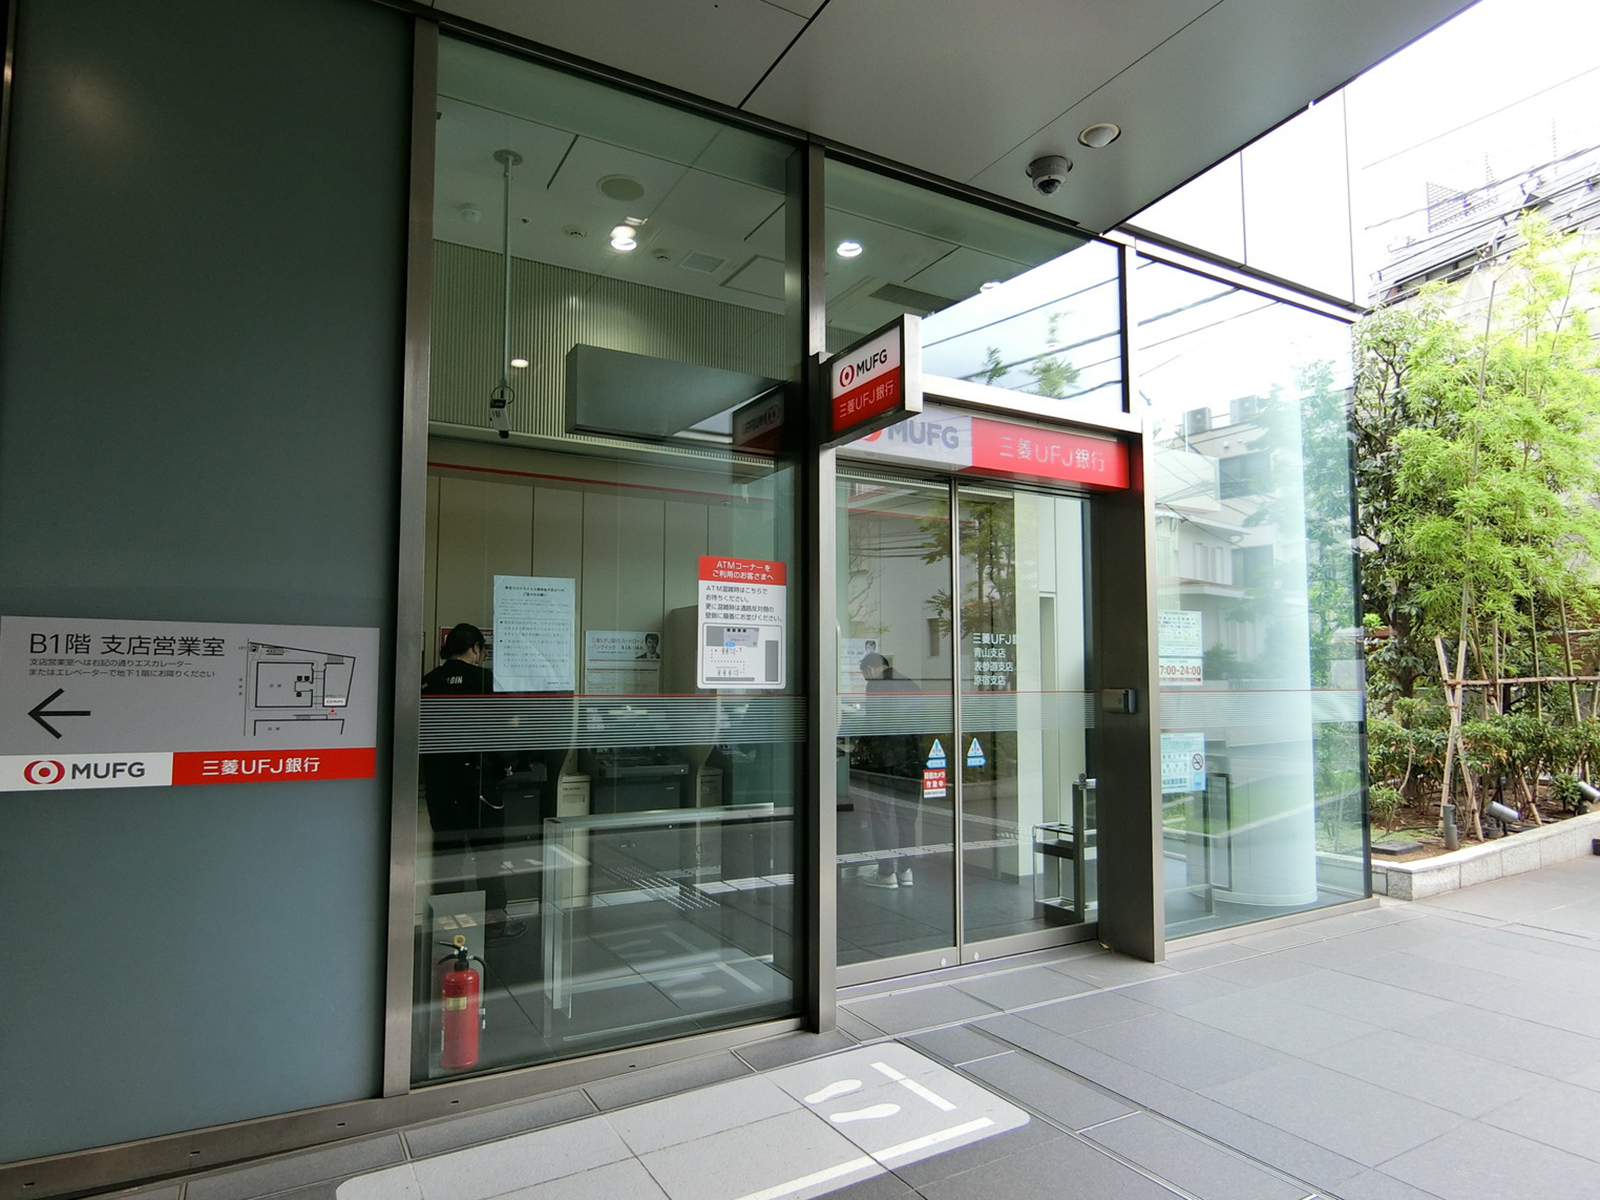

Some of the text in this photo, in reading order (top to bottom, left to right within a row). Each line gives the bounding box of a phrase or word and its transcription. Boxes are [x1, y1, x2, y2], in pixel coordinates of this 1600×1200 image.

[856, 348, 888, 377] MUFG
[839, 379, 895, 418] 三菱UFJ銀行
[888, 419, 959, 450] MUFG
[1000, 436, 1106, 472] 三菱UFJ銀行
[712, 569, 774, 581] ご利用のお客さまへ
[716, 560, 772, 572] ATMコーナーを
[29, 633, 226, 658] B1階 支店営業室
[973, 647, 1006, 658] 青山支店
[973, 661, 1014, 672] 表参道支店
[973, 675, 1006, 686] 原宿支店
[71, 761, 146, 780] MUFG
[201, 757, 321, 777] 三菱UFJ銀行
